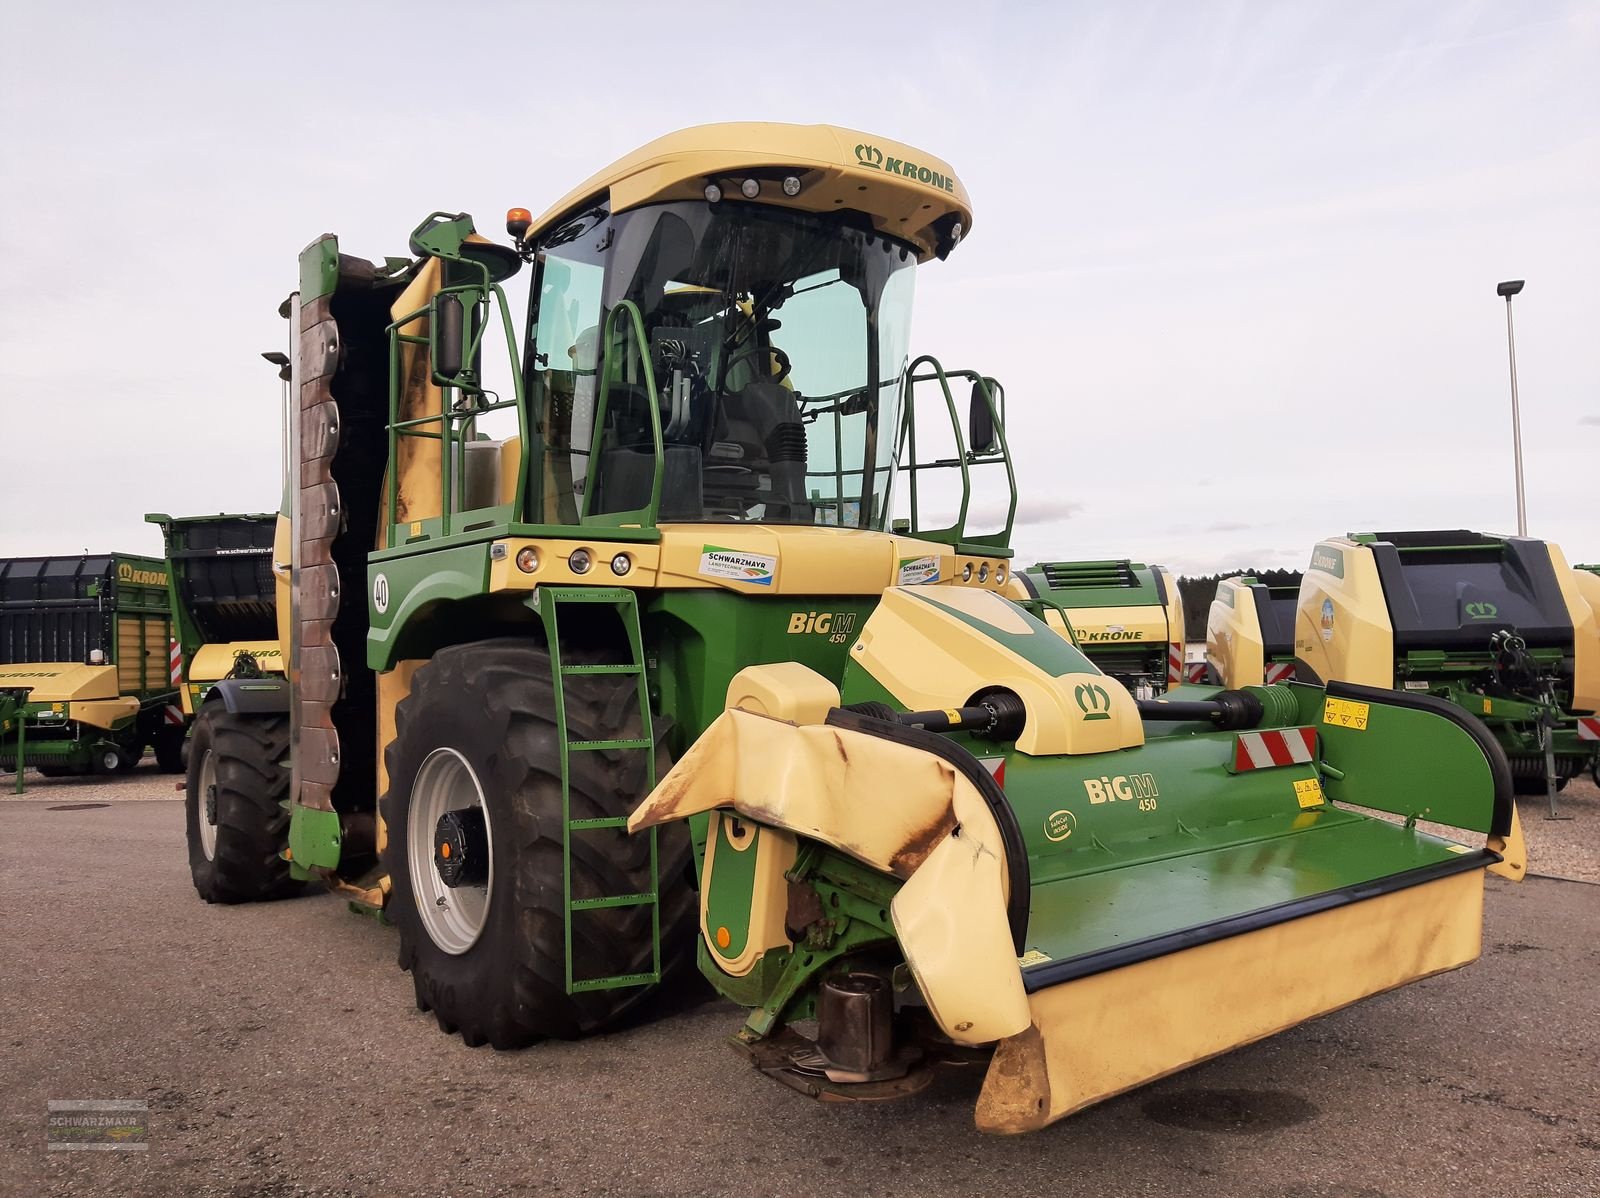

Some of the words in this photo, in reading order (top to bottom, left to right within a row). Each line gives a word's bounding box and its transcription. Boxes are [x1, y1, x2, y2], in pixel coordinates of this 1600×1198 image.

[885, 157, 953, 192] KRONE
[708, 552, 766, 569] SCHWARZMAYR
[132, 570, 168, 585] KRON
[375, 579, 387, 607] 40
[828, 633, 847, 644] 450
[1088, 631, 1144, 641] KRONE
[250, 649, 282, 658] KRO
[1138, 798, 1157, 812] 450
